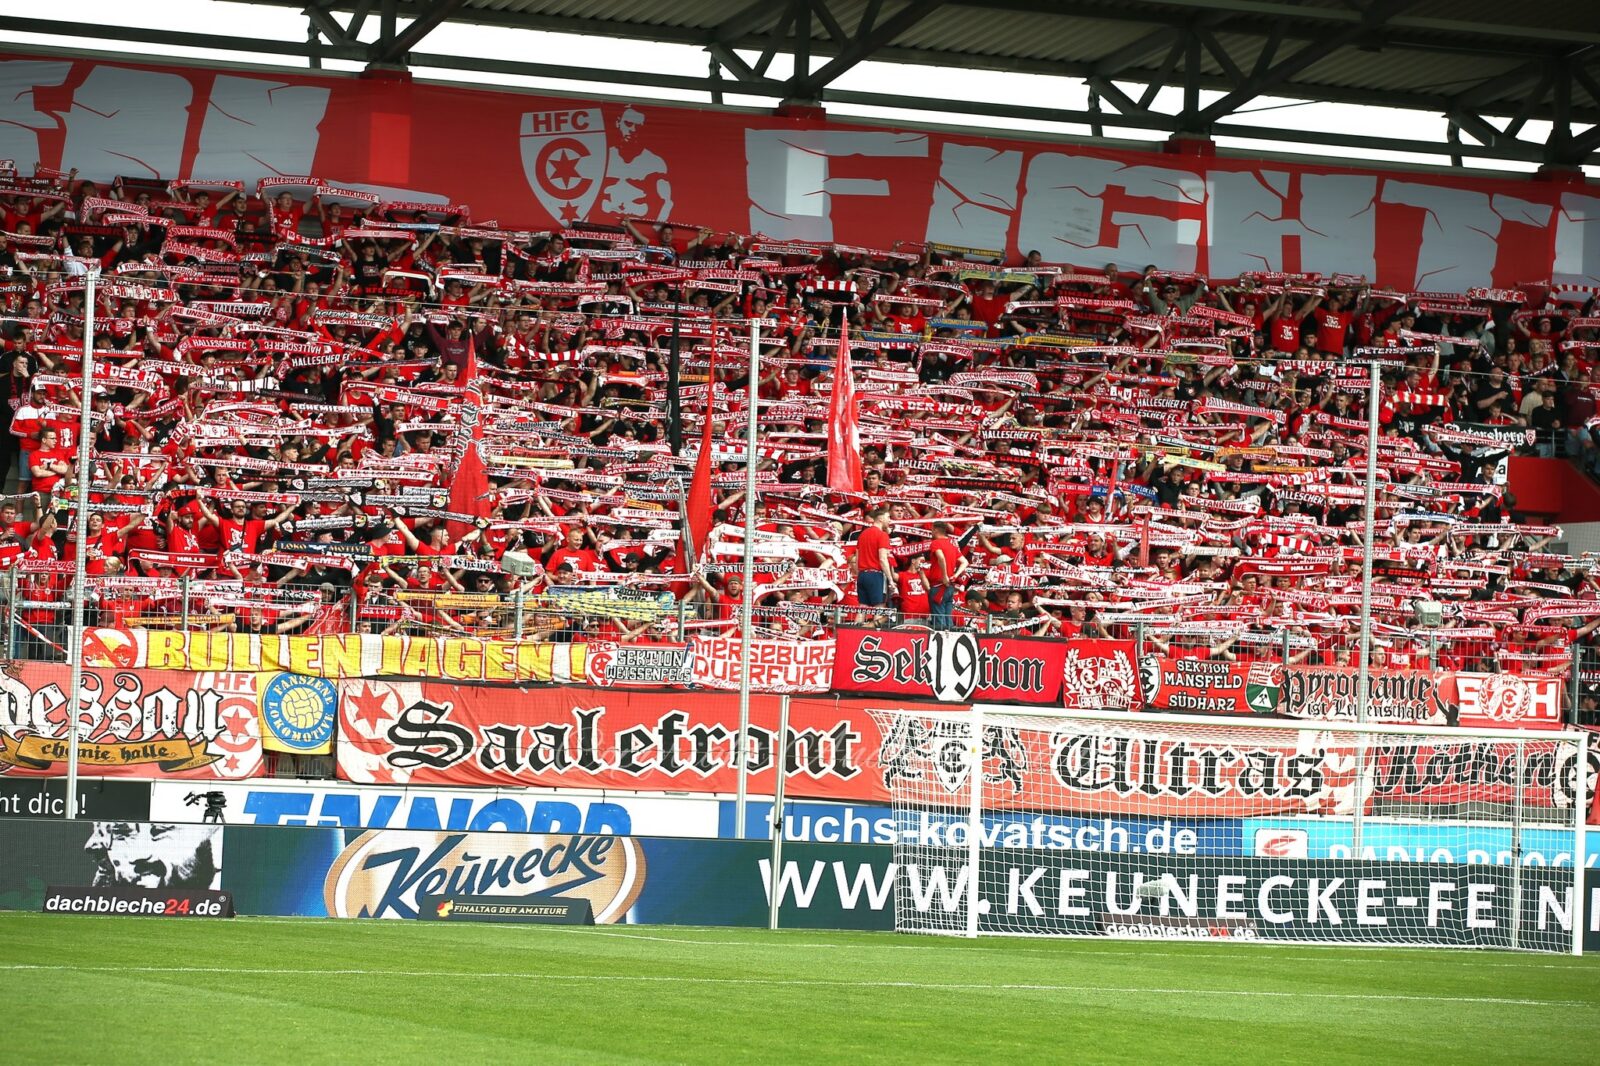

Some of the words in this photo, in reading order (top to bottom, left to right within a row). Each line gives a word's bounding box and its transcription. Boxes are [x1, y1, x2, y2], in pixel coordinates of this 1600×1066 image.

[533, 111, 589, 132] HFC
[263, 177, 309, 186] HALLESCHER
[310, 177, 320, 185] FC
[718, 259, 728, 269] FC
[213, 303, 262, 315] HALLESCHER
[264, 306, 274, 317] FC
[193, 338, 236, 349] HALLESCHER
[237, 342, 248, 350] FC
[273, 341, 322, 354] HALLESCHER
[291, 353, 340, 367] HALLESCHER
[681, 358, 742, 370] Traditinsclub
[109, 365, 134, 380] DER
[878, 399, 905, 411] NUR
[907, 401, 934, 412] DER
[1136, 398, 1179, 409] HALLESCHER
[1179, 400, 1190, 410] FC
[1119, 407, 1166, 421] HALLESCHER
[1167, 413, 1178, 422] FC
[982, 430, 1029, 440] HALLESCHER
[1029, 432, 1040, 441] FC
[1186, 496, 1247, 511] HFC-FANKURVE
[280, 543, 307, 551] LOKO
[328, 545, 369, 553] MOTIVE
[453, 558, 498, 571] Chemie
[160, 579, 172, 588] FC
[147, 632, 361, 678] BULLEN
[616, 649, 684, 668] SEKTION
[605, 665, 692, 682] WEISSENFELS
[1176, 660, 1230, 674] SEKTION
[1164, 671, 1243, 690] MANSFELD
[272, 675, 335, 706] FANSZENE
[1168, 692, 1236, 711] SÜDHARZ
[1333, 700, 1429, 722] Leienschaft
[269, 702, 334, 743] LOKOMOTIVE
[386, 700, 863, 780] Saalefront
[41, 740, 116, 764] chmie
[119, 741, 169, 763] halle
[454, 904, 498, 914] FINALTAG
[499, 905, 518, 914] DER
[518, 906, 569, 916] AMATEURE
